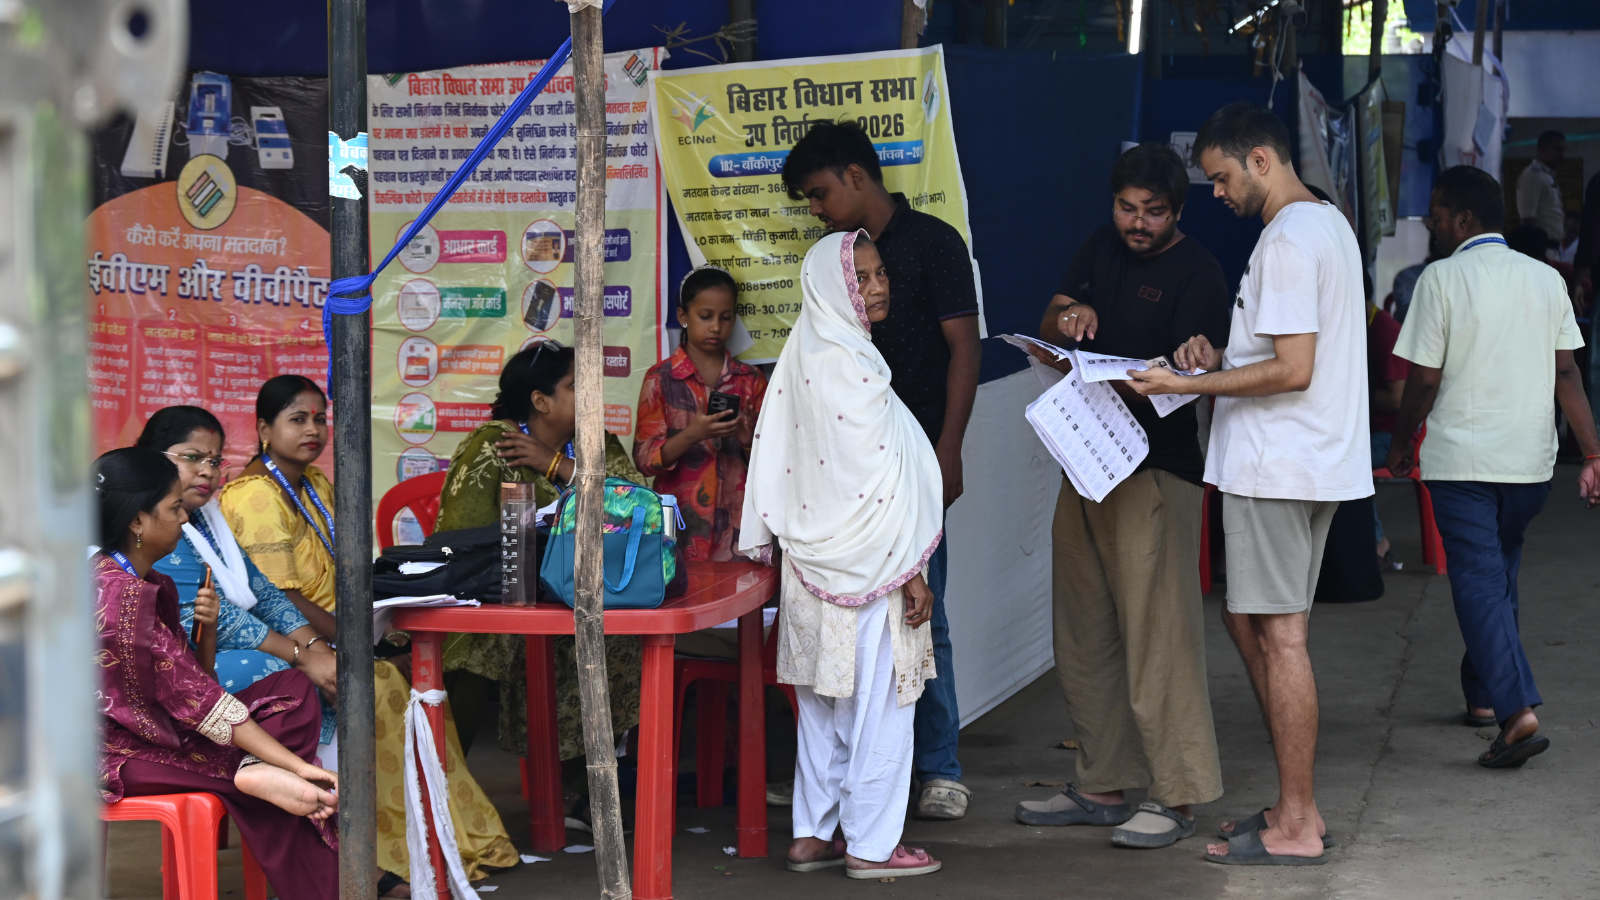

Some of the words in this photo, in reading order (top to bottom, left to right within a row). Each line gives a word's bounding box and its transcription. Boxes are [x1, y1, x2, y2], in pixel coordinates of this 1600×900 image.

[407, 73, 441, 96] बिहार
[442, 73, 477, 96] विधान
[480, 77, 506, 95] सभा
[507, 77, 525, 94] उप
[727, 83, 788, 114] बिहार
[793, 78, 863, 108] विधान
[869, 77, 917, 103] सभा
[372, 103, 379, 117] के
[380, 103, 393, 118] लिए
[395, 103, 412, 118] सभी
[414, 103, 442, 117] निर्वाचक
[462, 103, 489, 117] निर्वाचक
[534, 105, 545, 116] पत्र
[546, 101, 563, 116] जारी
[632, 100, 647, 113] स्थल
[372, 128, 382, 139] पर
[384, 128, 403, 139] अपना
[420, 124, 442, 139] डालने
[443, 124, 451, 138] से
[453, 124, 468, 138] पहले
[516, 123, 547, 142] सुनिश्चित
[548, 123, 567, 138] करने
[632, 120, 648, 135] फोटो
[742, 123, 767, 147] उप
[678, 135, 717, 146] ECINet
[373, 150, 396, 161] पहचान
[397, 150, 409, 161] पत्र
[411, 146, 436, 161] दिखाने
[438, 149, 450, 160] का
[497, 149, 510, 160] गया
[523, 145, 536, 160] ऐसे
[538, 145, 567, 160] निर्वाचक
[630, 142, 648, 157] फोटो
[373, 171, 396, 183] पहचान
[398, 171, 409, 182] पत्र
[404, 189, 422, 204] फोटो
[506, 192, 519, 203] एक
[520, 189, 548, 203] दस्तावेज
[548, 192, 567, 206] प्रस्तुत
[682, 187, 709, 199] मतदान
[710, 184, 731, 197] केन्द्र
[685, 211, 713, 222] मतदान
[713, 208, 733, 221] केन्द्र
[734, 209, 748, 219] का
[749, 208, 770, 218] नाम
[126, 222, 156, 246] कैसे
[158, 226, 180, 248] करें
[182, 234, 223, 251] अपना
[224, 234, 287, 256] मतदान?
[444, 239, 475, 254] आधार
[476, 234, 498, 254] कार्ड
[708, 235, 719, 245] का
[742, 229, 767, 242] पिंकी
[735, 257, 752, 268] पता
[87, 251, 170, 295] ईवीएम
[178, 258, 226, 301] और
[485, 293, 502, 310] कार्ड
[99, 303, 105, 316] 1
[168, 308, 176, 321] 2
[229, 314, 237, 327] 3
[300, 319, 309, 330] 4
[144, 327, 179, 339] मतदान
[179, 328, 197, 341] करें
[606, 353, 628, 367] दस्तावेज
[275, 470, 290, 487] INDIA
[286, 485, 296, 497] OF
